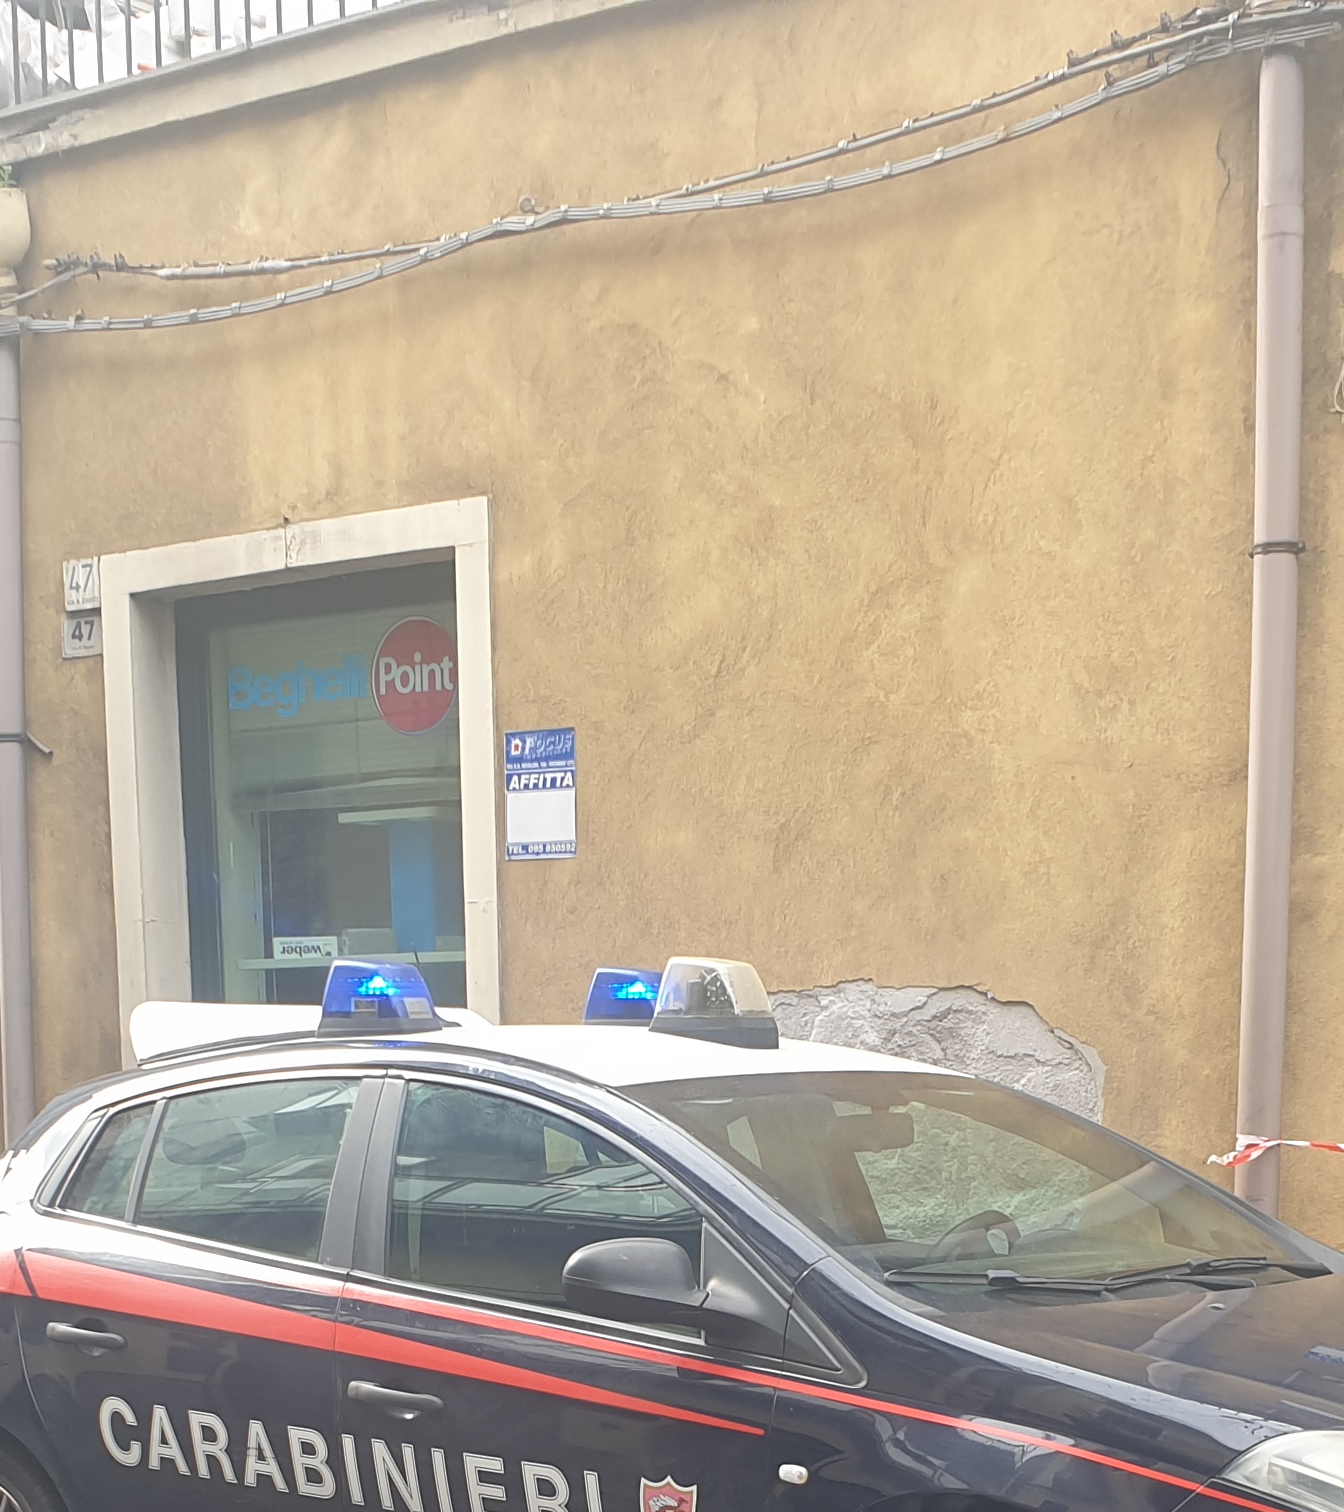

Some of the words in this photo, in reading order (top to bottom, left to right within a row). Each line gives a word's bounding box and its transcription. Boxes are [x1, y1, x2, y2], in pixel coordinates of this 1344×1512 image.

[69, 563, 93, 593] 47
[71, 620, 95, 642] 47
[228, 652, 368, 719] Beghelli
[379, 651, 454, 695] Point
[509, 771, 574, 791] AFFITTA
